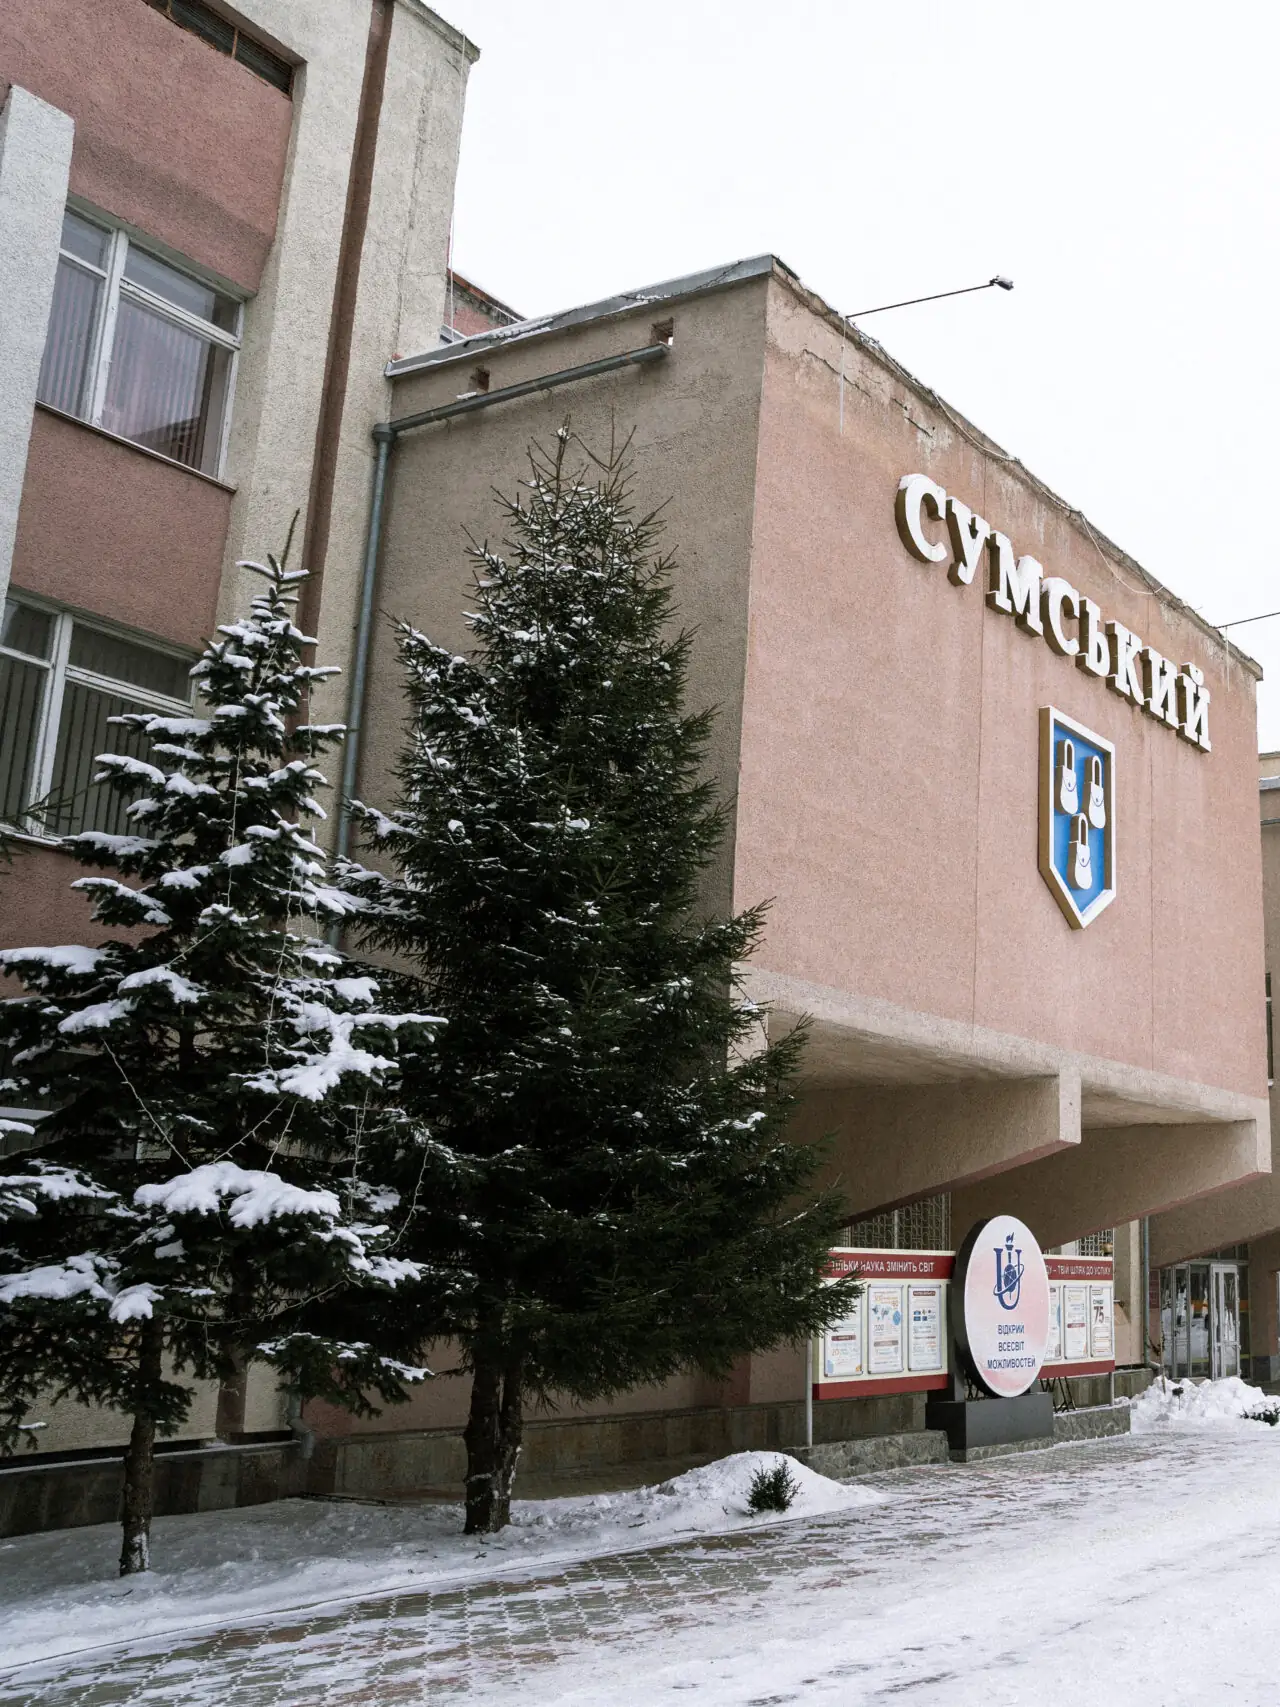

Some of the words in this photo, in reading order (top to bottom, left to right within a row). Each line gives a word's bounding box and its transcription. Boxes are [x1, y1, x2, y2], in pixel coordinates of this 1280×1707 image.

[895, 473, 1211, 752] СУМСЬКИЙ
[860, 1260, 885, 1272] НАУКА
[886, 1260, 917, 1273] ЗМІНИТЬ
[918, 1261, 935, 1273] СВІТ
[997, 1322, 1025, 1336] ВІДКРИЙ
[998, 1341, 1025, 1352] ВСЕСВІТ
[987, 1355, 1036, 1370] МОЖЛИВОСТЕЙ
